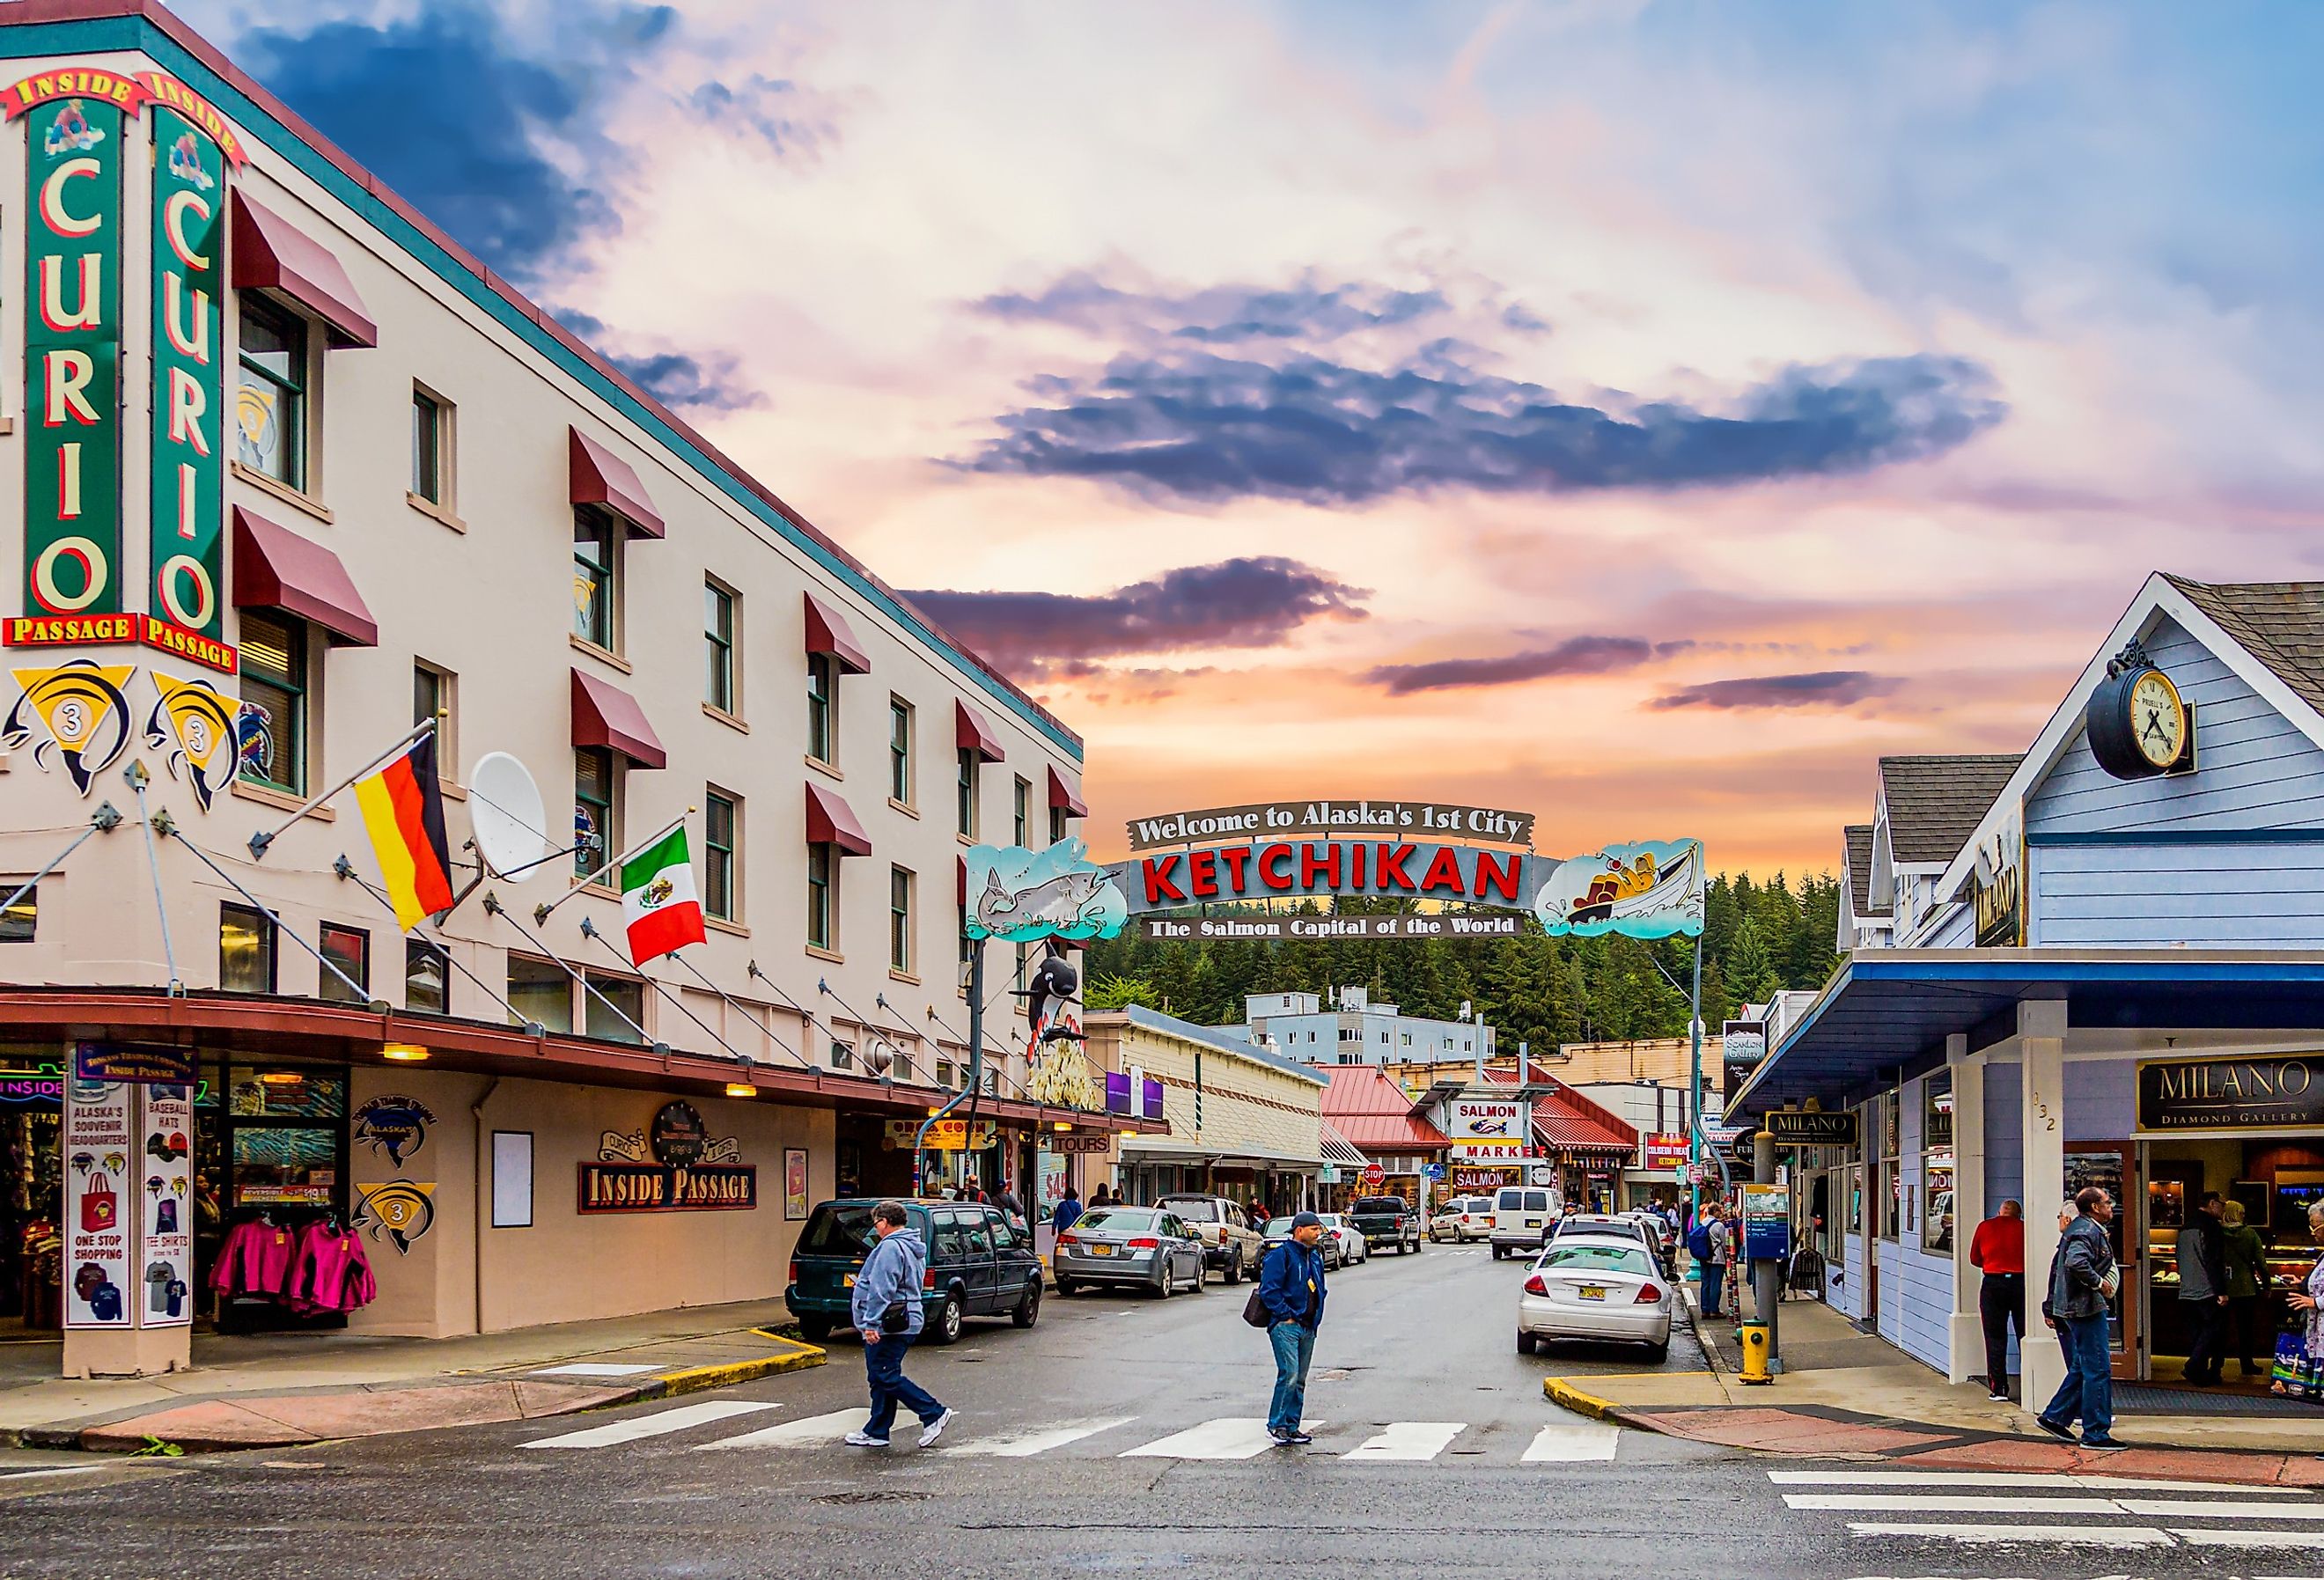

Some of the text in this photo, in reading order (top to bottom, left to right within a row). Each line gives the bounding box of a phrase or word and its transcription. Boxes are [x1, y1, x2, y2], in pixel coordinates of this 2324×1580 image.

[14, 71, 133, 105] INSIDE
[151, 74, 236, 155] INSIDE
[32, 158, 108, 614] CURIO
[159, 191, 215, 631] CURIO
[13, 618, 130, 642] PASSAGE
[148, 624, 232, 669] PASSAGE
[61, 702, 83, 737] 3
[189, 719, 206, 753] 3
[1137, 802, 1524, 843] Welcome to Alaska's 1st City
[1141, 843, 1522, 903] KETCHIKAN
[1149, 917, 1514, 938] The Salmon Capital of the World
[0, 1081, 64, 1094] INSIDE
[2159, 1061, 2312, 1099] MILANO
[74, 1106, 123, 1118] ALASKA'S
[149, 1102, 188, 1115] BASEBALL
[1460, 1105, 1517, 1118] SALMON
[2034, 1091, 2056, 1132] 132
[74, 1120, 122, 1132] SOUVENIR
[158, 1117, 179, 1128] HATS
[1778, 1116, 1847, 1132] MILANO
[2162, 1112, 2308, 1124] DIAMOND GALLERY
[70, 1135, 128, 1145] HEADQUARTERS
[1055, 1137, 1107, 1151] TOURS
[1467, 1146, 1547, 1157] MARKET
[1365, 1170, 1384, 1179] STOP
[1457, 1172, 1504, 1187] SALMON
[590, 1169, 749, 1202] INSIDE PASSAGE
[390, 1203, 404, 1222] 3
[75, 1235, 121, 1246] ONE STOP
[145, 1235, 188, 1247] TEE SHIRTS
[74, 1249, 123, 1260] SHOPPING
